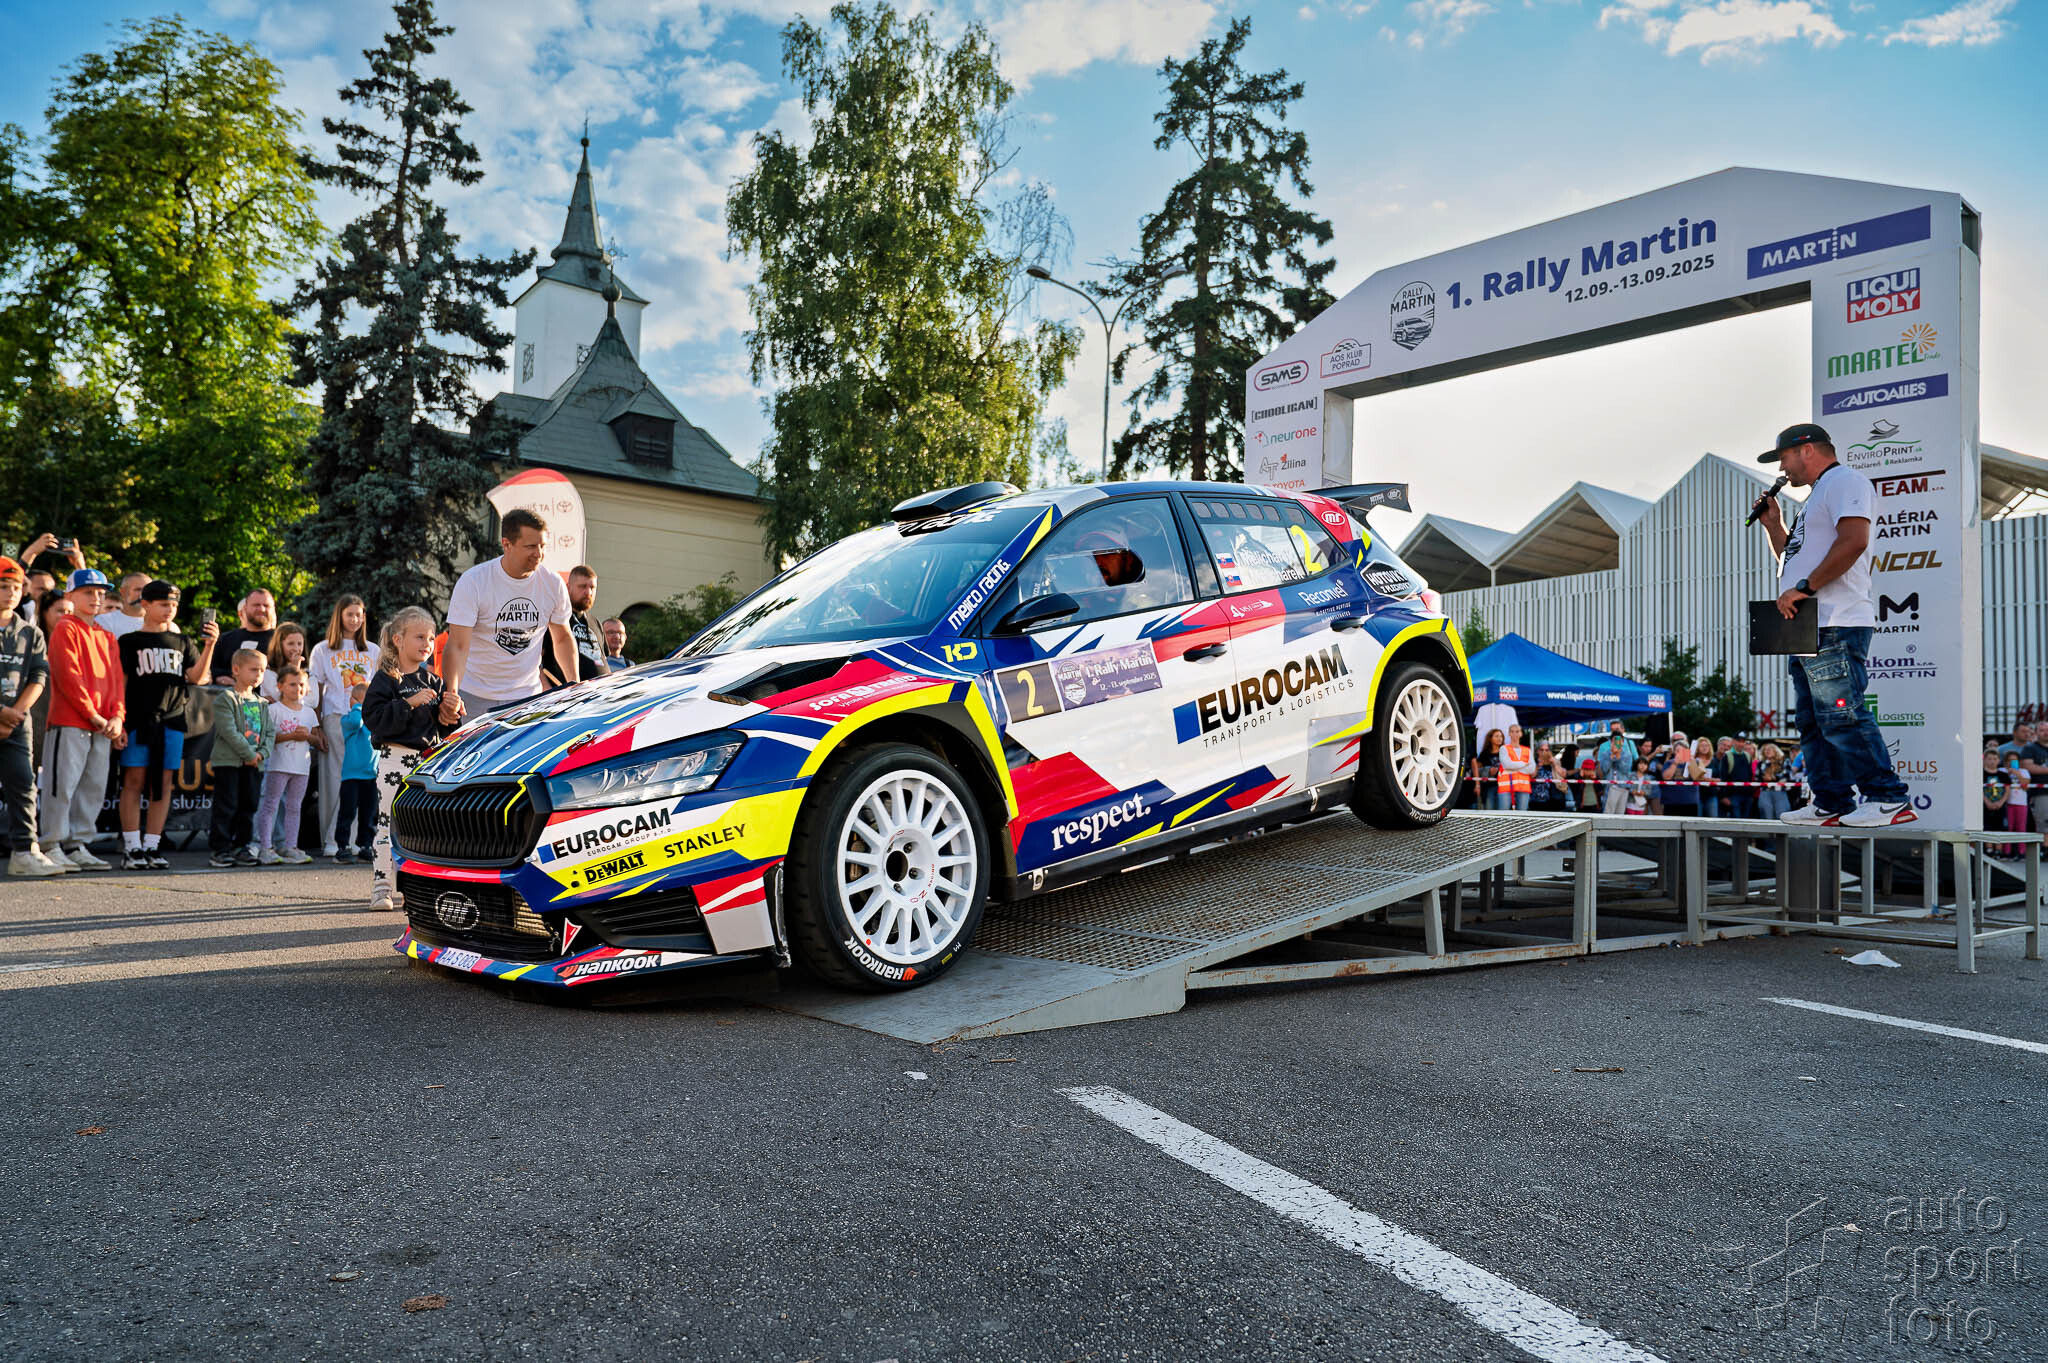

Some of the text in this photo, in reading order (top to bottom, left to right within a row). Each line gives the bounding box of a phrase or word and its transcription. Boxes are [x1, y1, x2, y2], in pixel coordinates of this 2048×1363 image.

[1447, 218, 1716, 308] 1. Rally Martin
[1762, 231, 1857, 268] MARTIN
[1565, 254, 1714, 303] 12.09.-13.09.2025
[1850, 270, 1917, 300] LIQUI
[1391, 292, 1435, 313] MARTIN
[1403, 286, 1423, 299] RALLY
[1850, 290, 1918, 321] MOLY
[1330, 350, 1363, 364] AOS KLUB
[1332, 358, 1360, 371] POPRAD
[1828, 341, 1924, 378] MARTEL
[1847, 382, 1926, 407] AUTOALLES
[1270, 426, 1317, 444] neurone
[1876, 509, 1938, 526] ALÉRIA
[1876, 523, 1931, 539] ARTIN
[1291, 525, 1322, 571] 2
[1870, 550, 1943, 576] NCOL
[496, 611, 540, 622] MARTIN
[509, 602, 530, 612] RALLY
[136, 648, 184, 677] JOKER
[1095, 660, 1120, 676] Rally
[1120, 655, 1153, 671] Martin
[1017, 669, 1045, 717] 2
[1198, 643, 1349, 734] EUROCAM
[1203, 679, 1354, 749] TRANSPORT & LOGISTICS
[1879, 712, 1925, 721] LOGISTICS
[553, 807, 671, 859] EUROCAM
[1051, 792, 1151, 851] respect.
[587, 842, 621, 857] EUROCAM
[625, 834, 650, 845] GROUP
[664, 823, 746, 859] STANLEY
